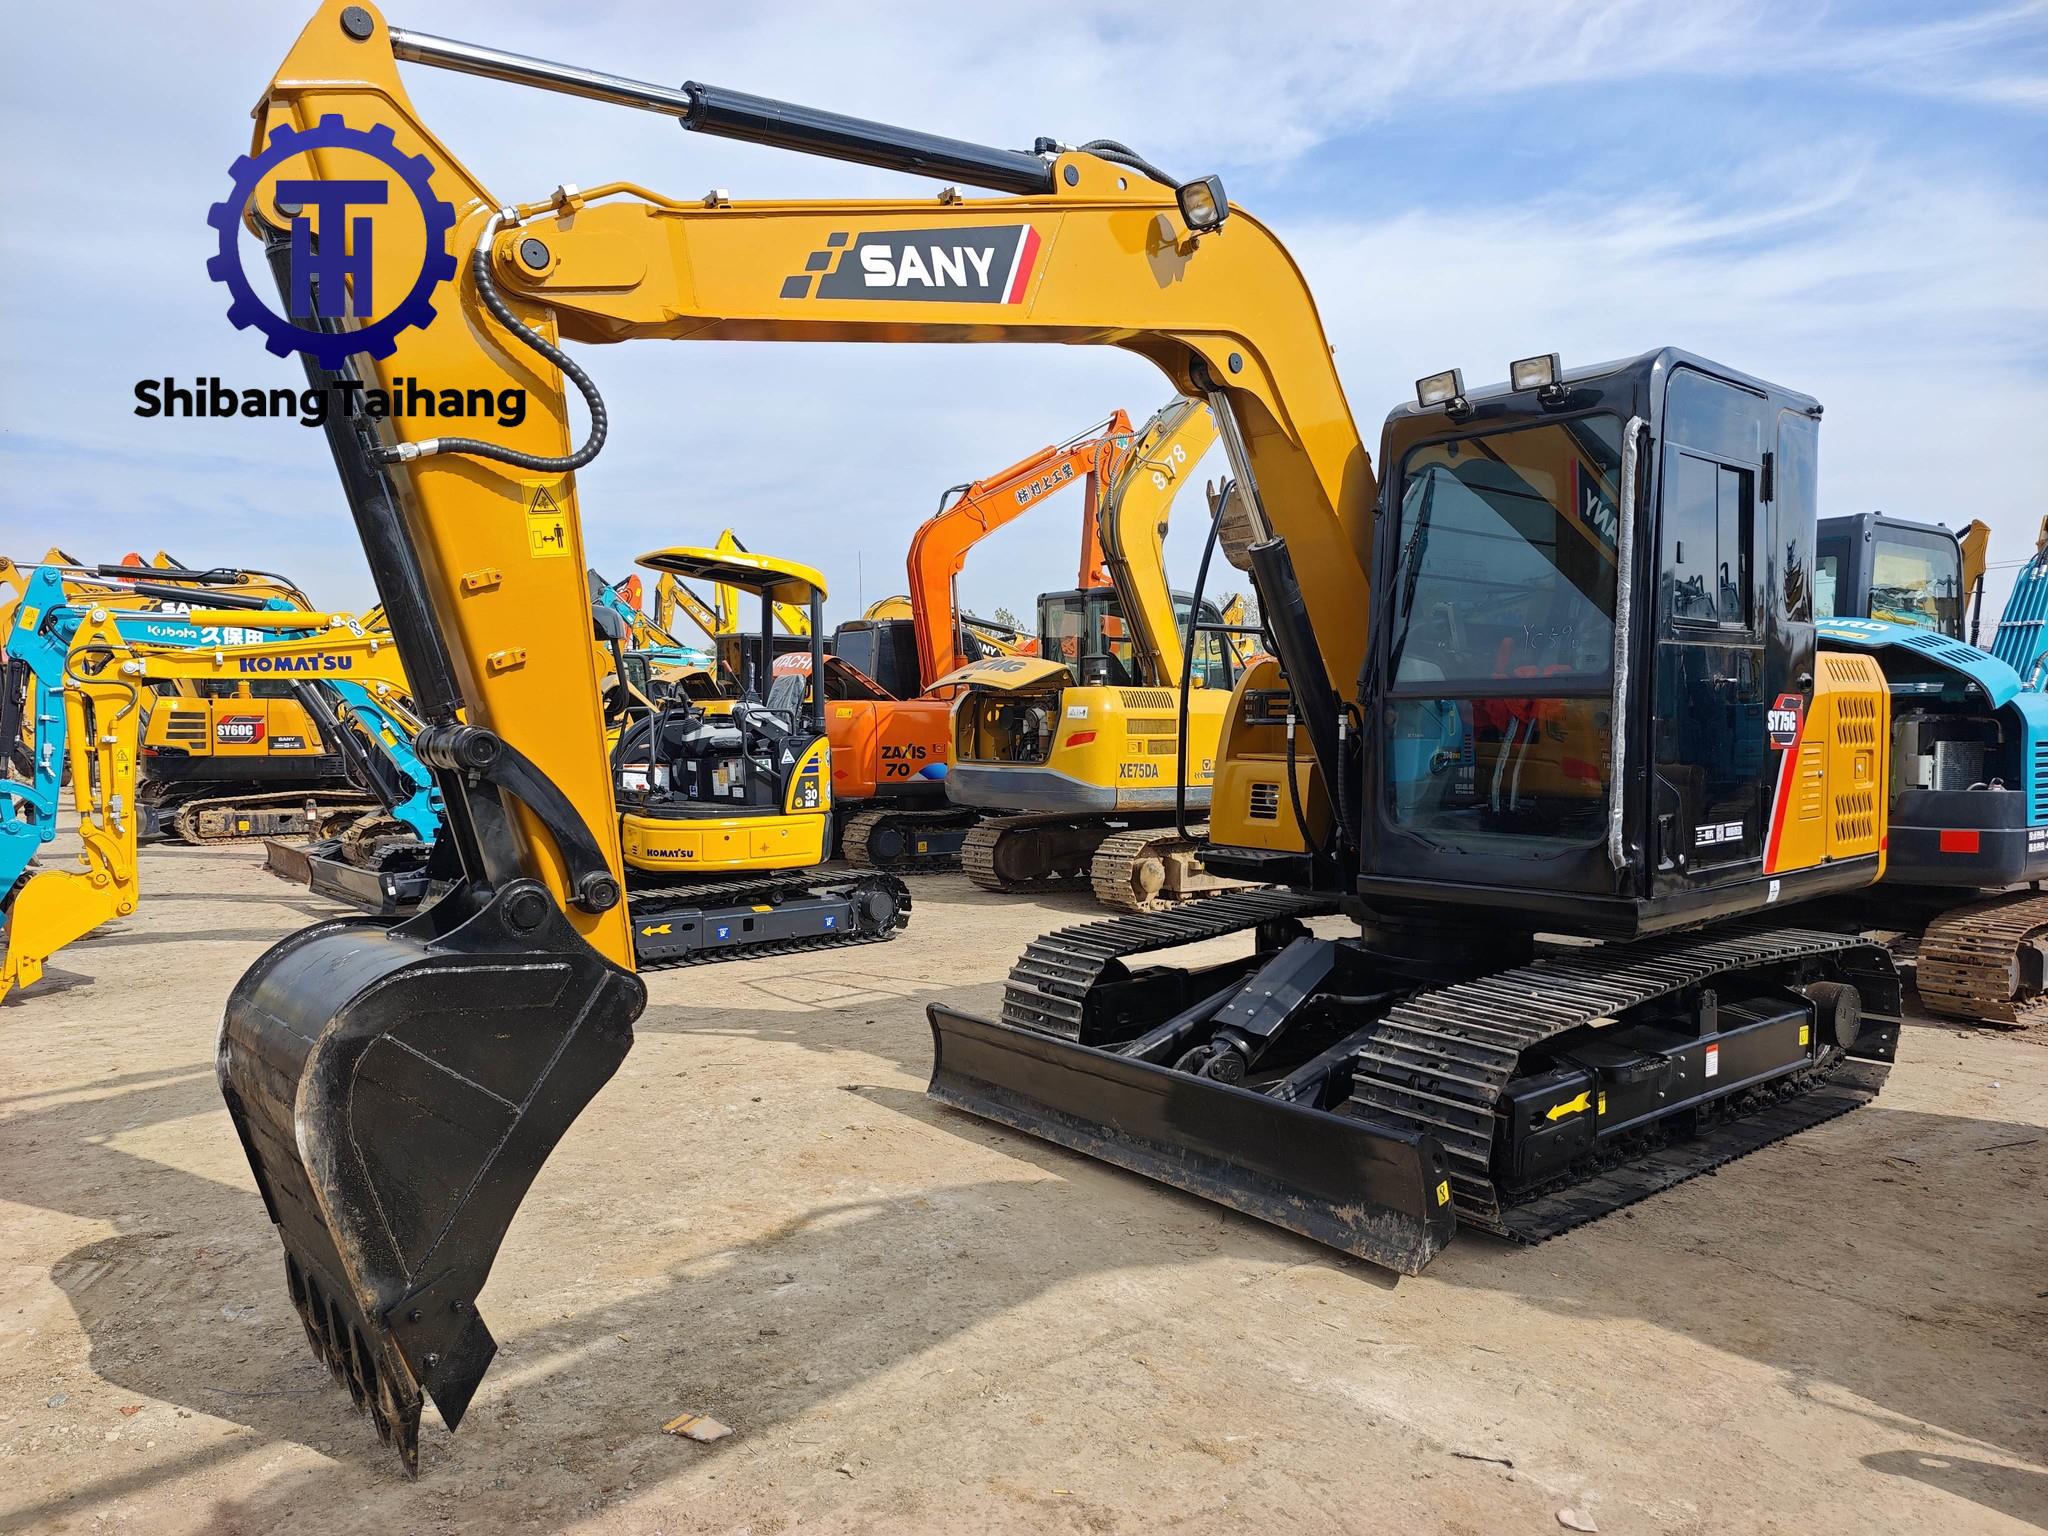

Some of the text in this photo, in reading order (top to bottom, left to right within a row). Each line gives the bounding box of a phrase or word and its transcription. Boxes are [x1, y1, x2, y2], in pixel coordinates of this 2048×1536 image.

[860, 244, 995, 288] SANY
[147, 624, 198, 639] Kubota
[200, 626, 264, 645] 久保田
[239, 652, 353, 673] KOMATSU
[1767, 710, 1796, 732] SY75C
[217, 724, 254, 737] SY60C
[881, 743, 927, 760] ZAXIS
[885, 763, 911, 777] 70
[1119, 763, 1159, 778] XE75DA
[804, 781, 815, 790] PC
[804, 789, 818, 800] 30
[646, 848, 694, 858] KOMATSU
